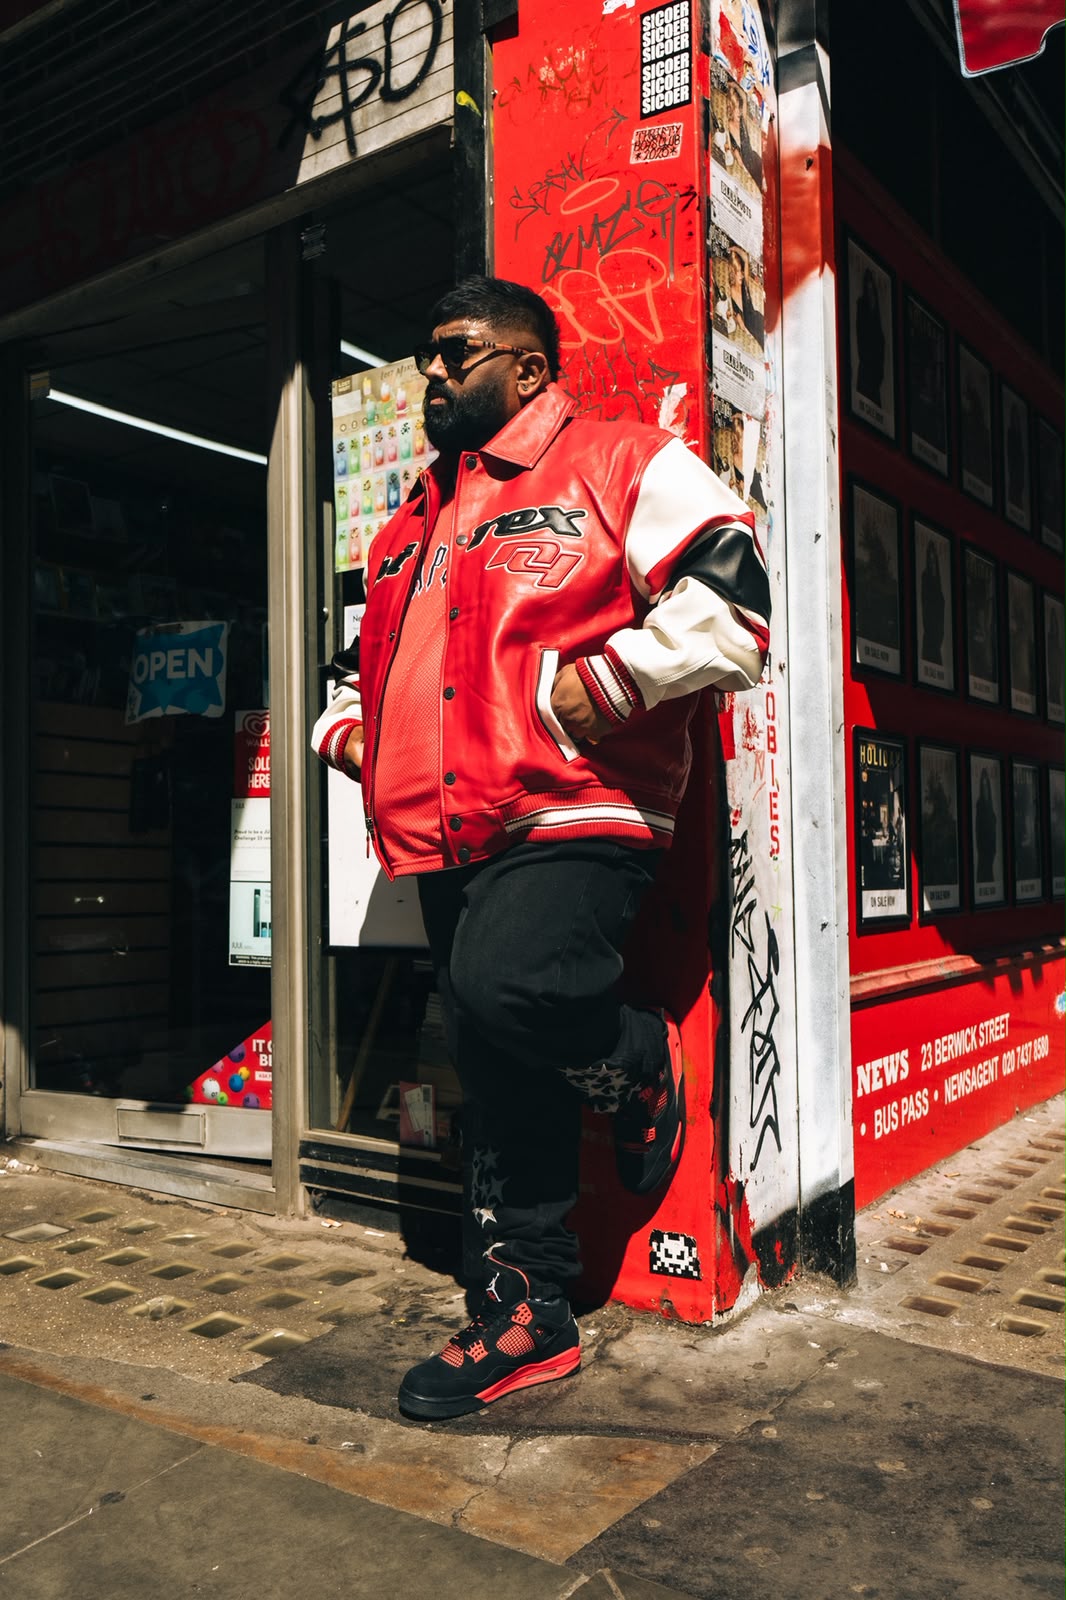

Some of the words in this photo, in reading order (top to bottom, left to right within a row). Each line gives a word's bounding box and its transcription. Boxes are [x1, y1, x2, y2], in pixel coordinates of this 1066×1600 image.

[642, 0, 690, 32] SICOER
[642, 16, 690, 48] SICOER
[642, 32, 690, 64] SICOER
[642, 51, 690, 82] SICOER
[642, 68, 690, 98] SICOER
[642, 84, 690, 114] SICOER
[133, 647, 214, 684] OPEN
[247, 773, 271, 788] HERE
[877, 896, 887, 907] SALE
[252, 1039, 265, 1052] IT
[856, 1049, 910, 1098] NEWS
[920, 1041, 933, 1072] 23
[934, 1024, 978, 1066] BERWICK
[978, 1012, 1011, 1047] STREET
[873, 1100, 899, 1140] BUS
[901, 1087, 929, 1127] PASS
[944, 1055, 1000, 1105] NEWSAGENT
[1002, 1049, 1015, 1077] 020
[1016, 1041, 1032, 1071] 7437
